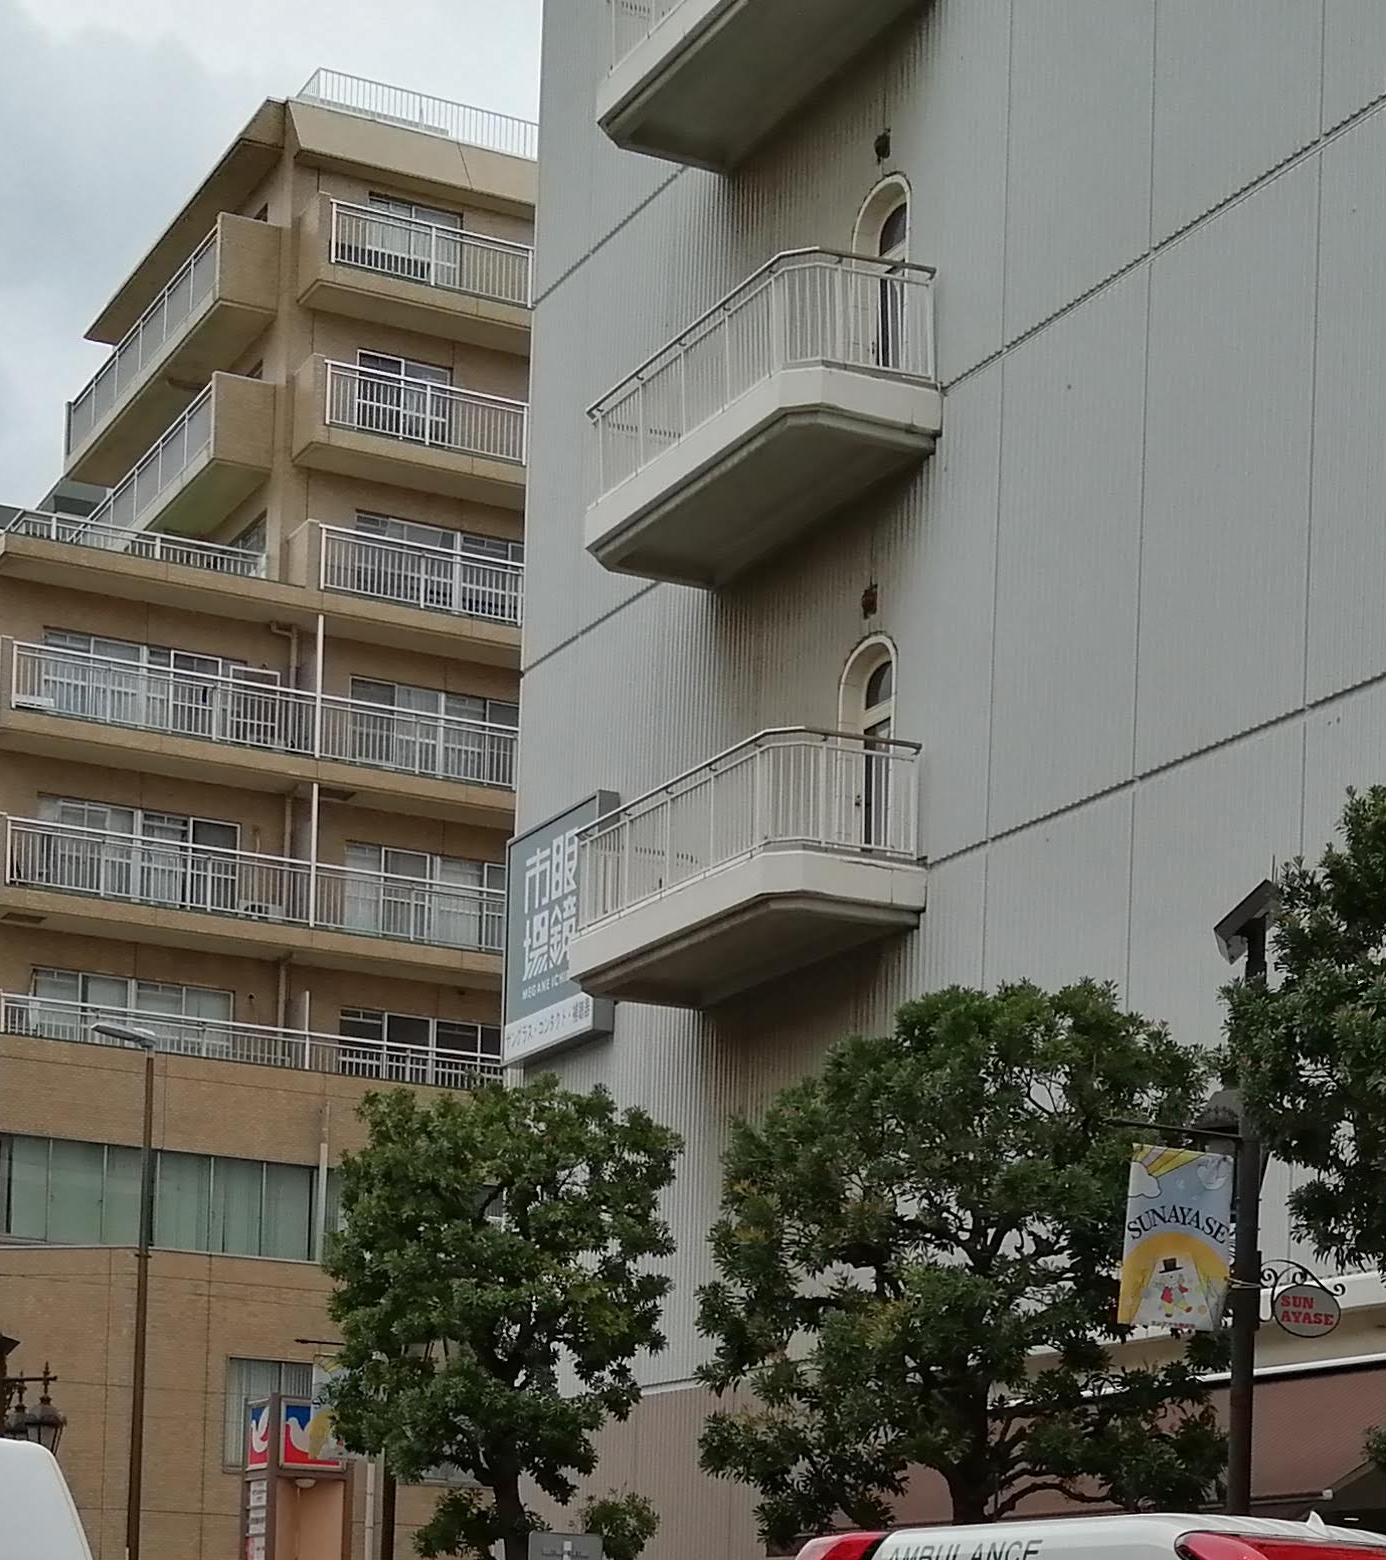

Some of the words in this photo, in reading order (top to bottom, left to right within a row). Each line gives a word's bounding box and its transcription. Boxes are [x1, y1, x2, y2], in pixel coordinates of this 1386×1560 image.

[1125, 1203, 1230, 1245] SUNAYASE
[1280, 1295, 1315, 1310] SUN
[1280, 1310, 1335, 1326] AYASE
